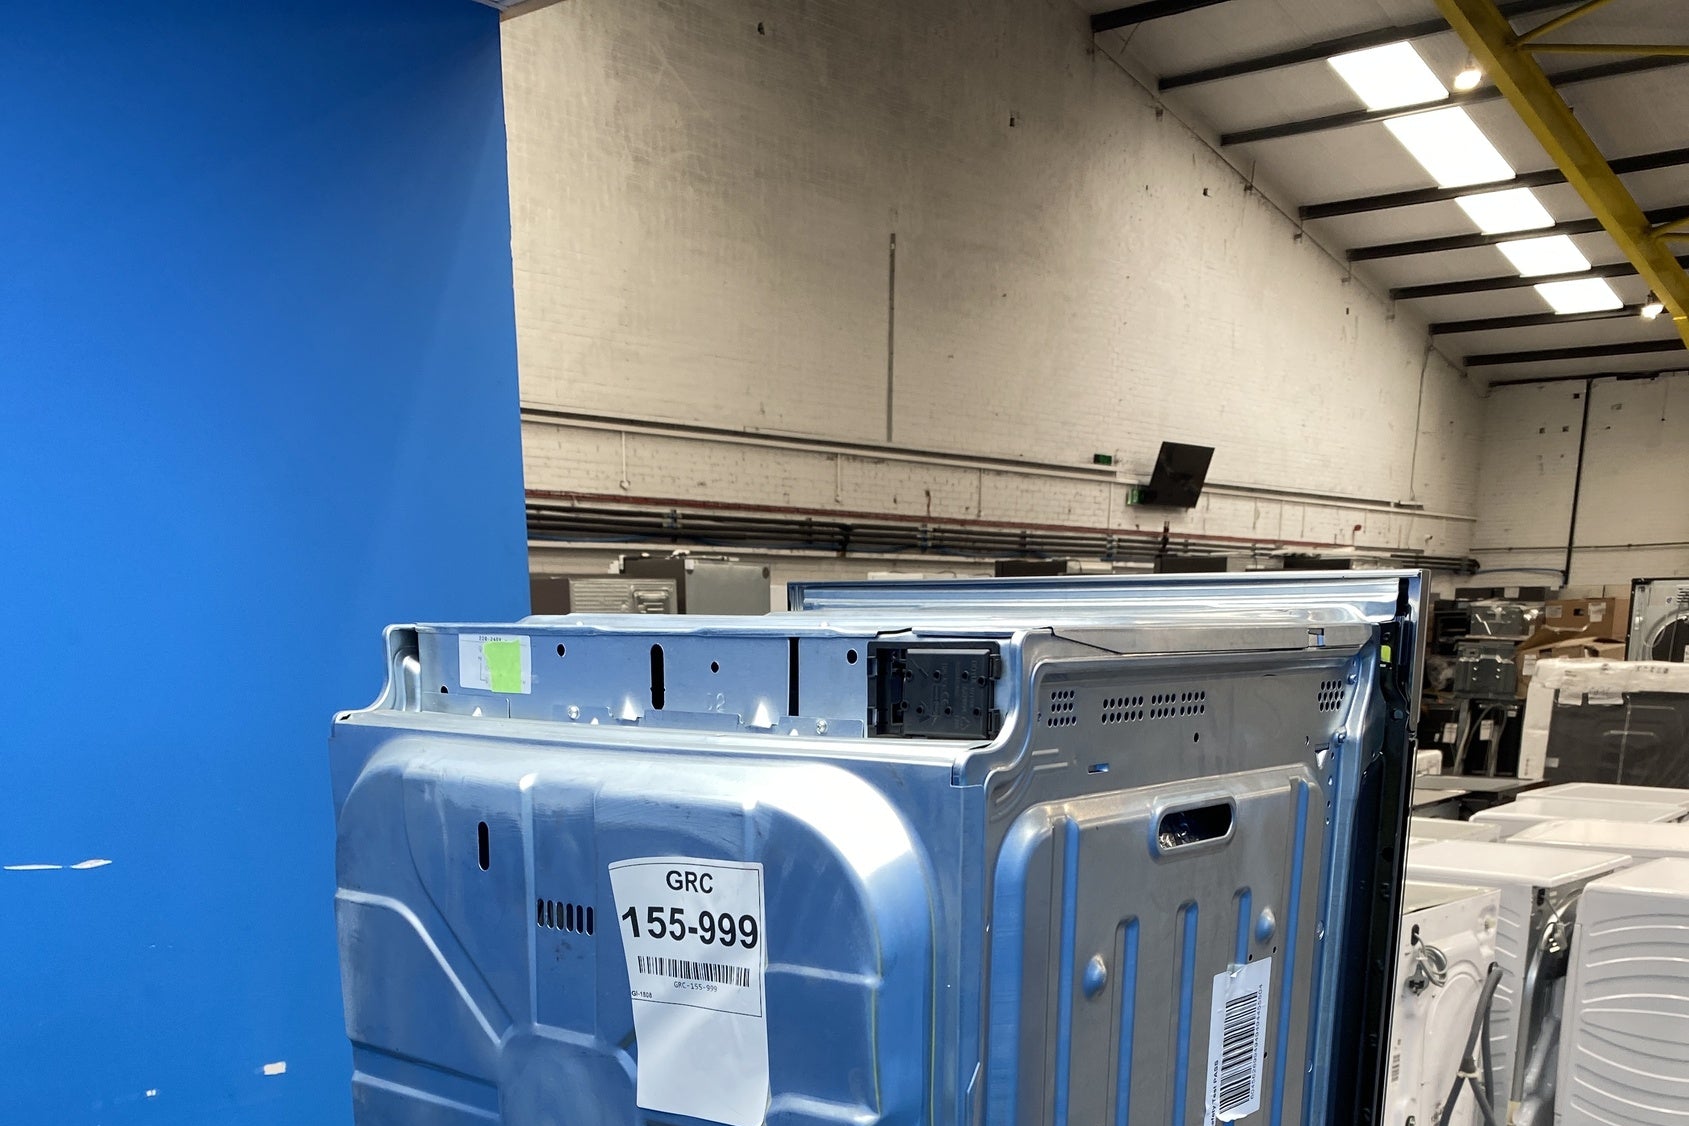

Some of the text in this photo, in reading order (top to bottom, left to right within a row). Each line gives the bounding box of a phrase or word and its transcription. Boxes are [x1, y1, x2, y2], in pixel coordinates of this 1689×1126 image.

[666, 870, 713, 894] GRC
[621, 906, 758, 949] 155-999
[673, 980, 718, 992] GRC-155-999
